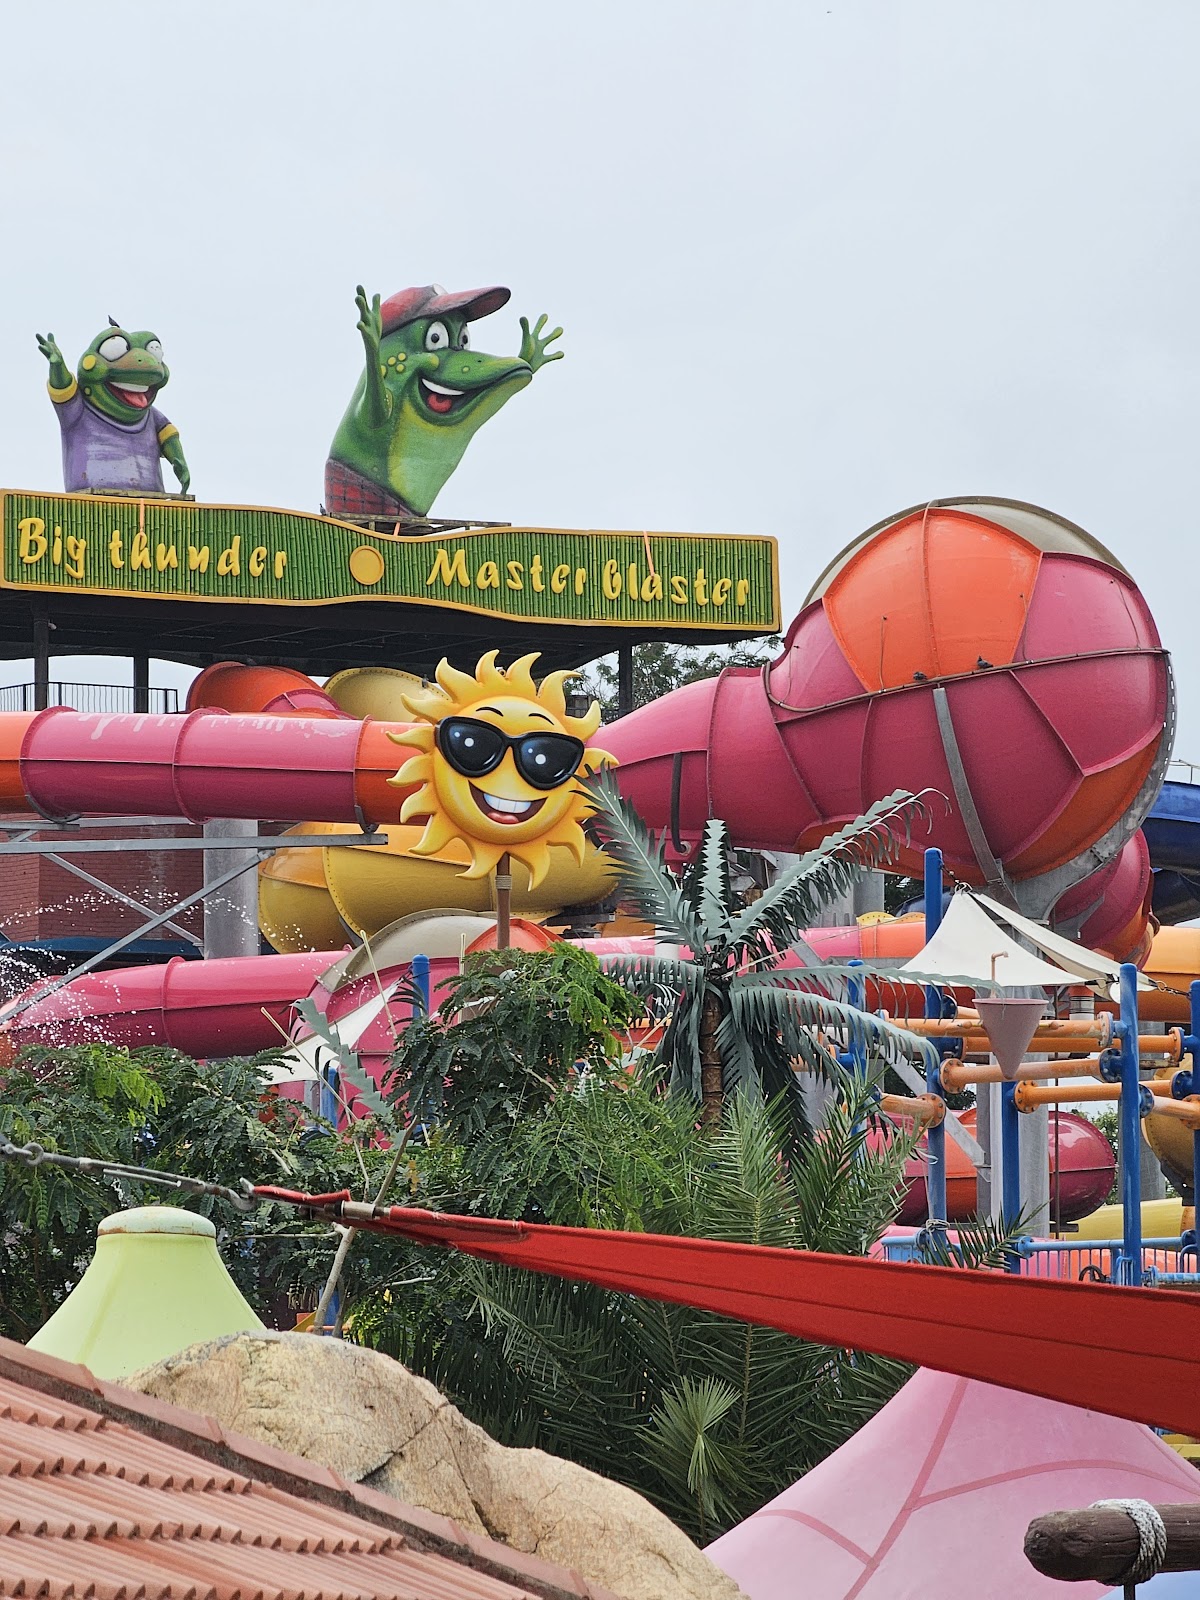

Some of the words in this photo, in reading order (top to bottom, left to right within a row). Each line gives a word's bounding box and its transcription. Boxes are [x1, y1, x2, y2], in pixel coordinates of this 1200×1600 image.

[18, 517, 87, 579] Big
[109, 529, 287, 579] thunder
[426, 548, 587, 596] Master
